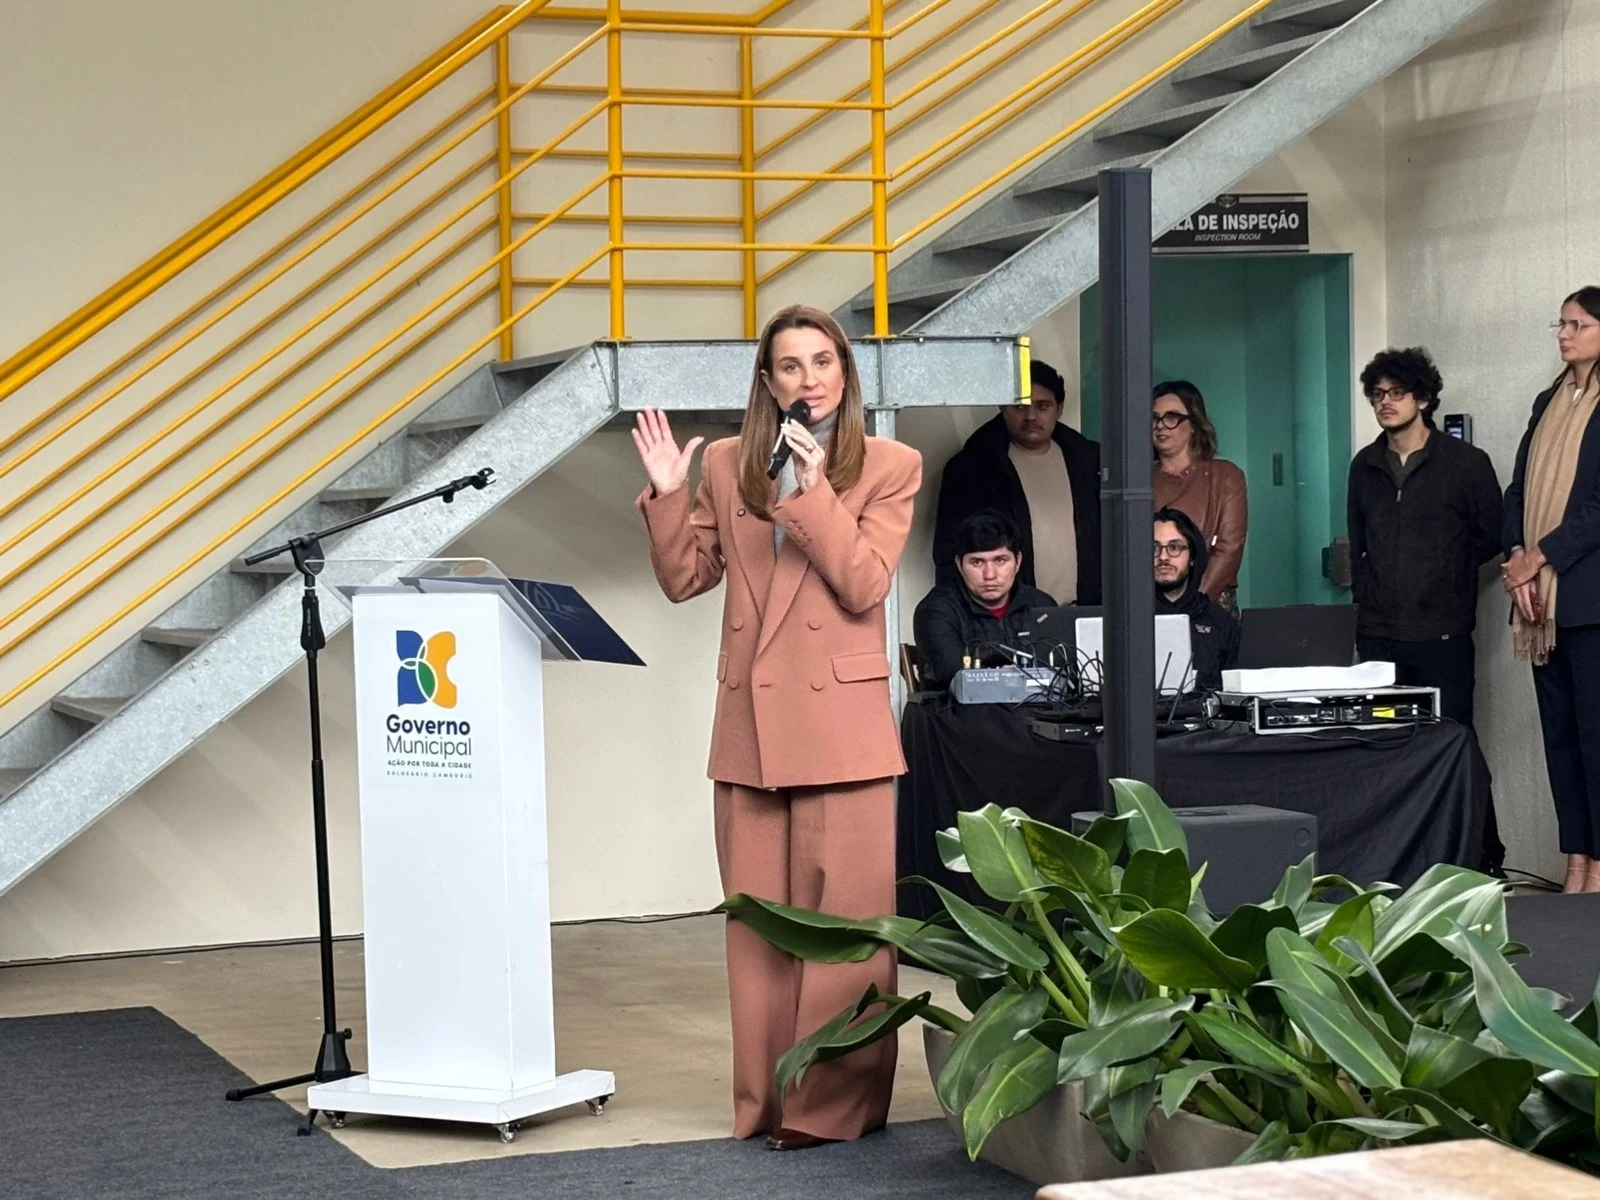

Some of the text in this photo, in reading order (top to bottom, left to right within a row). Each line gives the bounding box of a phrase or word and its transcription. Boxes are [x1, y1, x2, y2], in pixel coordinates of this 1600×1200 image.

[1197, 214, 1218, 230] DE
[1223, 210, 1300, 234] INSPEÇÃO
[1194, 233, 1261, 242] INSPECTION ROOM
[386, 714, 470, 735] Governo
[387, 735, 471, 759] Municipal
[387, 759, 406, 767] AÇÃO
